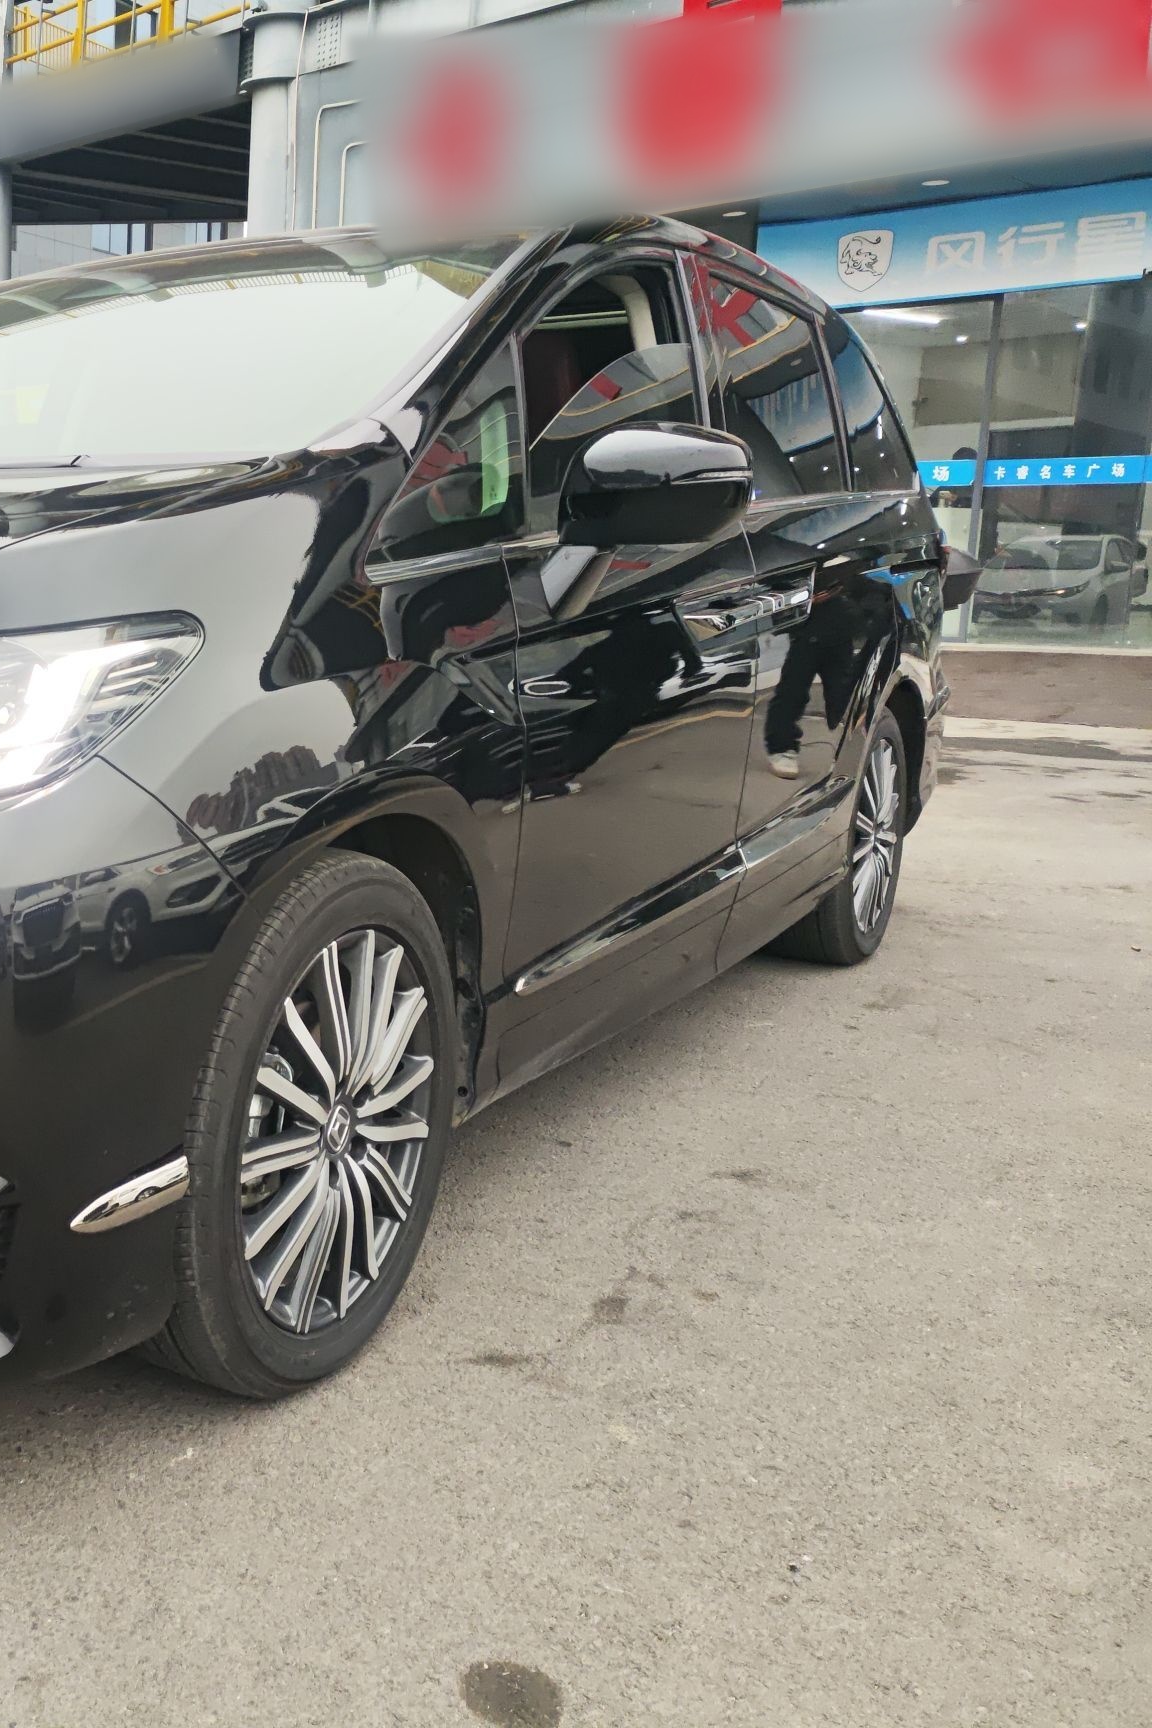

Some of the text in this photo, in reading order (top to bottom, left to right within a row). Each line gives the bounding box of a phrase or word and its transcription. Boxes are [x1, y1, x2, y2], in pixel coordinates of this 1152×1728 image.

[993, 463, 1125, 480] 卡睿名车广场
